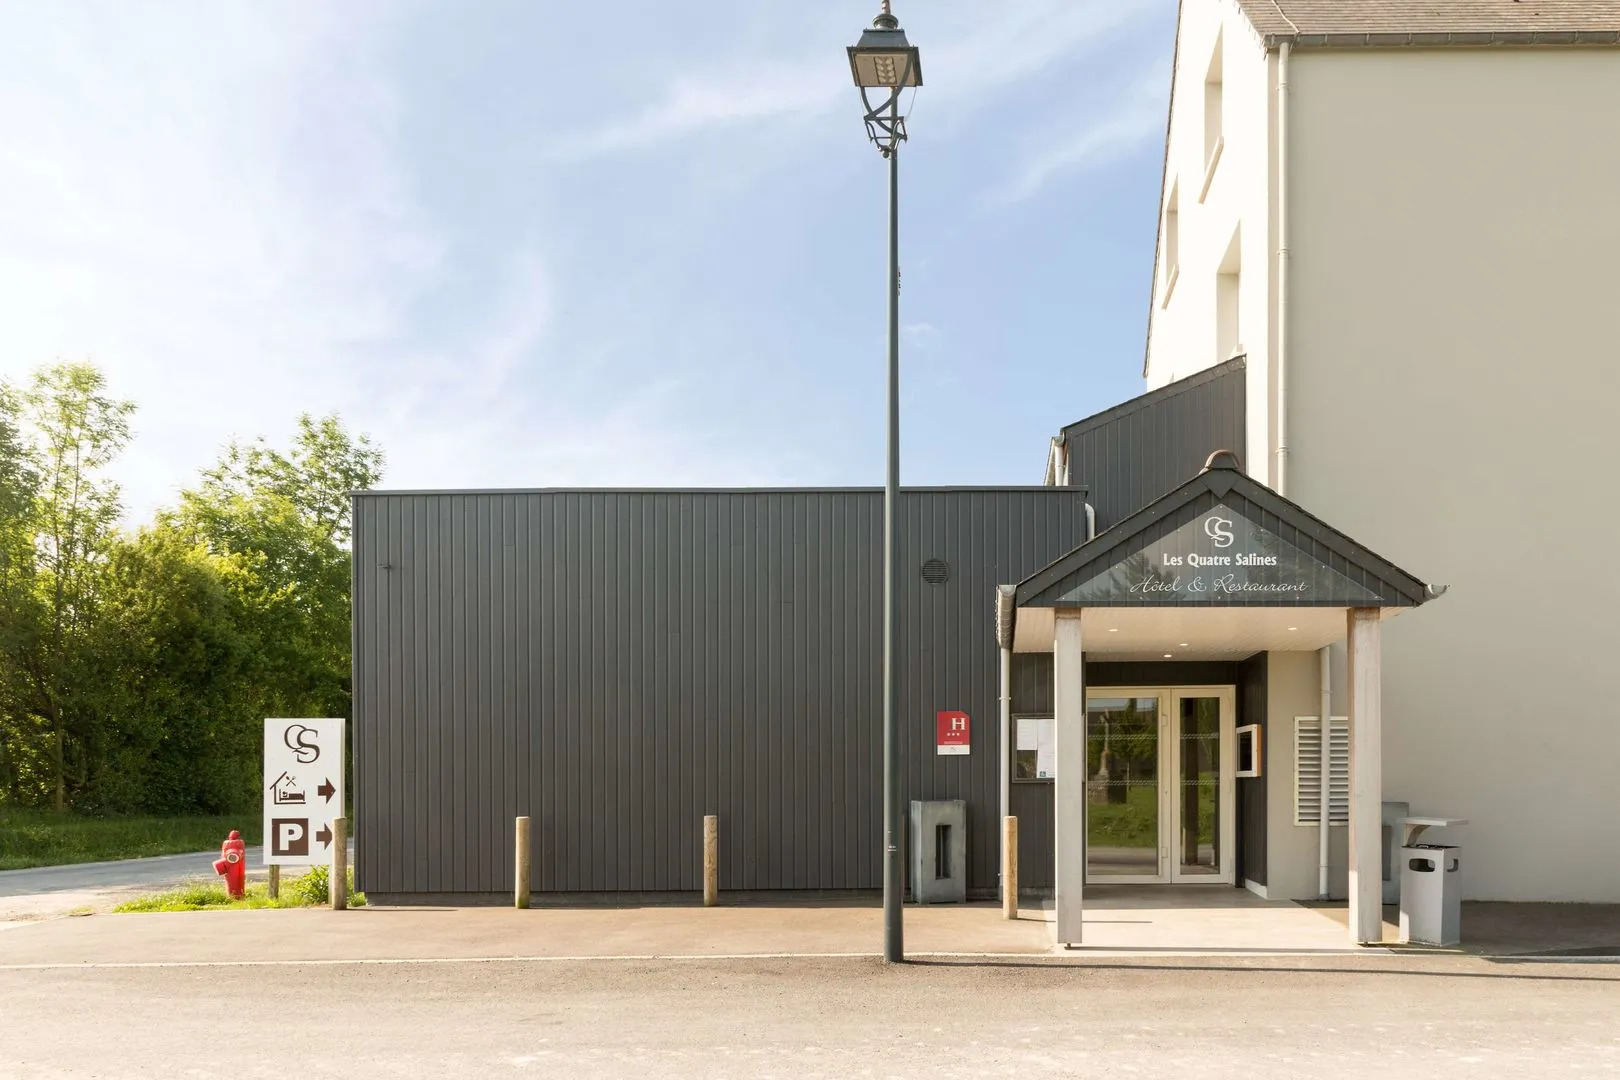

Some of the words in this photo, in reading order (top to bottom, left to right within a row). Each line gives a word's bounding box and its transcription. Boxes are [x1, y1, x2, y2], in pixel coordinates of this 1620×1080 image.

[1163, 553, 1183, 566] Les
[1187, 553, 1231, 568] Quatre
[1235, 553, 1277, 566] Salines
[1130, 575, 1182, 593] Hôtel
[1187, 576, 1207, 593] &
[1213, 573, 1309, 594] Restaurant
[952, 717, 966, 730] H
[279, 823, 303, 851] P
